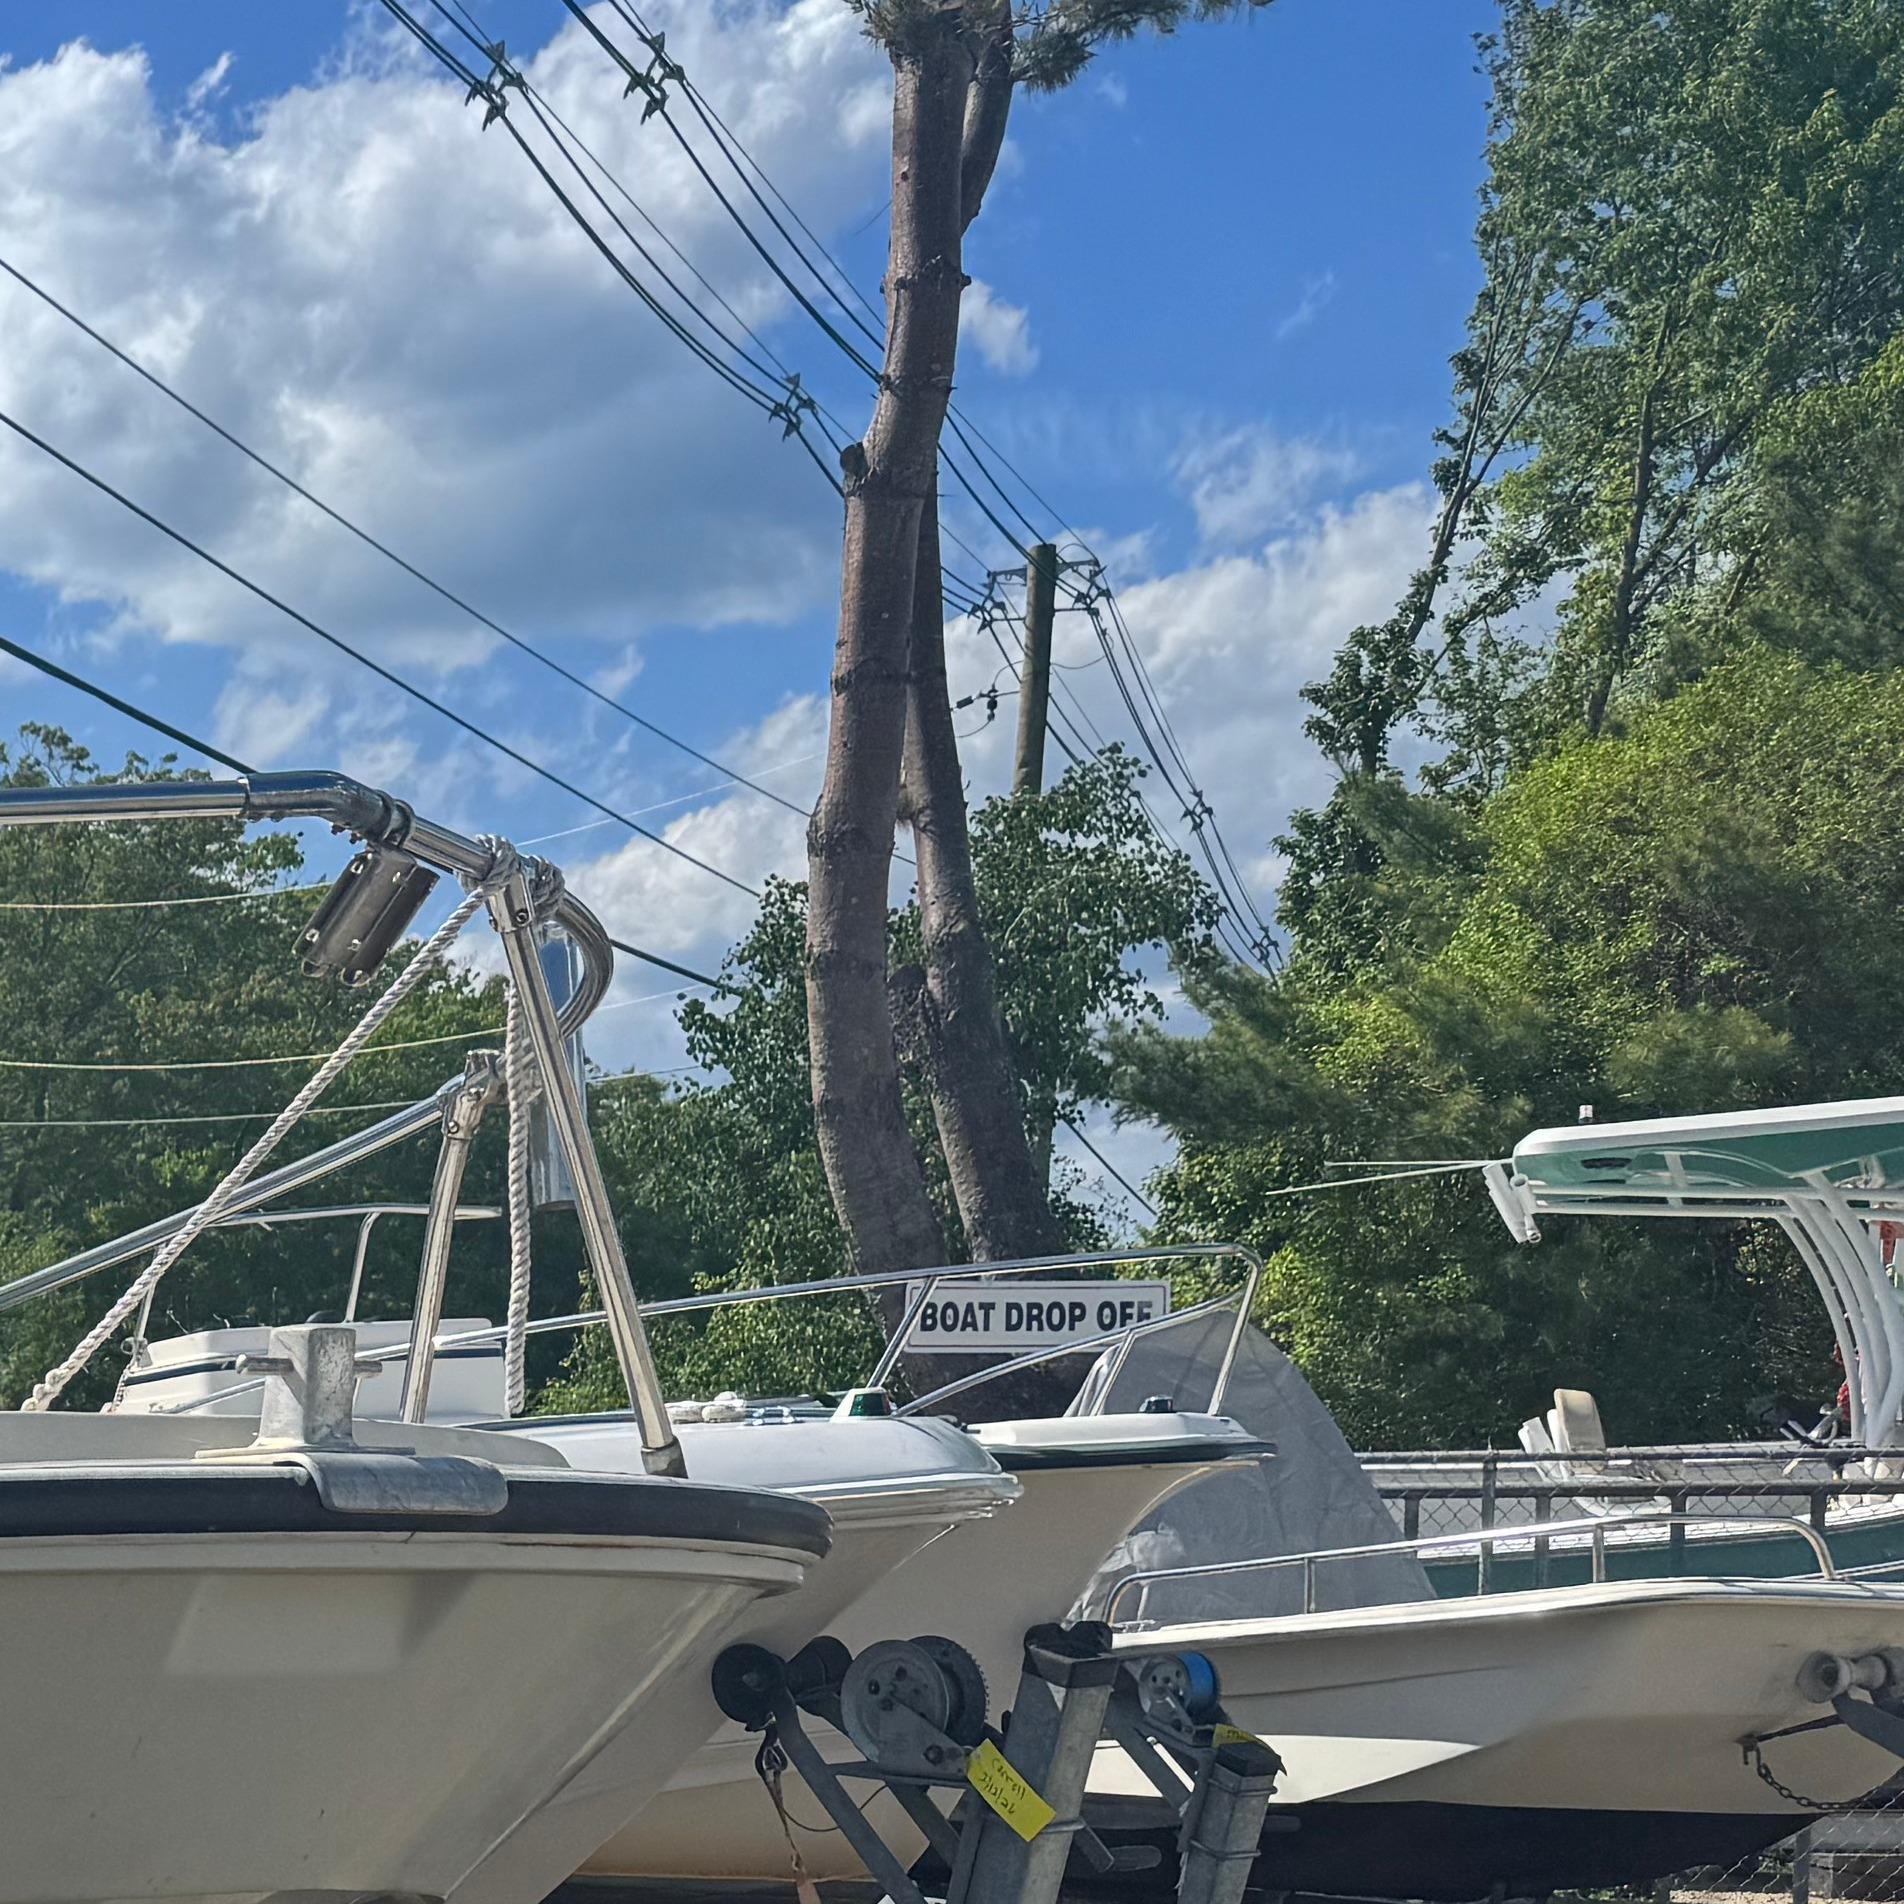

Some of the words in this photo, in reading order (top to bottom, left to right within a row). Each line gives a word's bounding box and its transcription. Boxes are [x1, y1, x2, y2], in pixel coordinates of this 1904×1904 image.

[920, 1300, 996, 1332] BOAT
[1005, 1301, 1087, 1332] DROP
[1096, 1300, 1153, 1332] OFF
